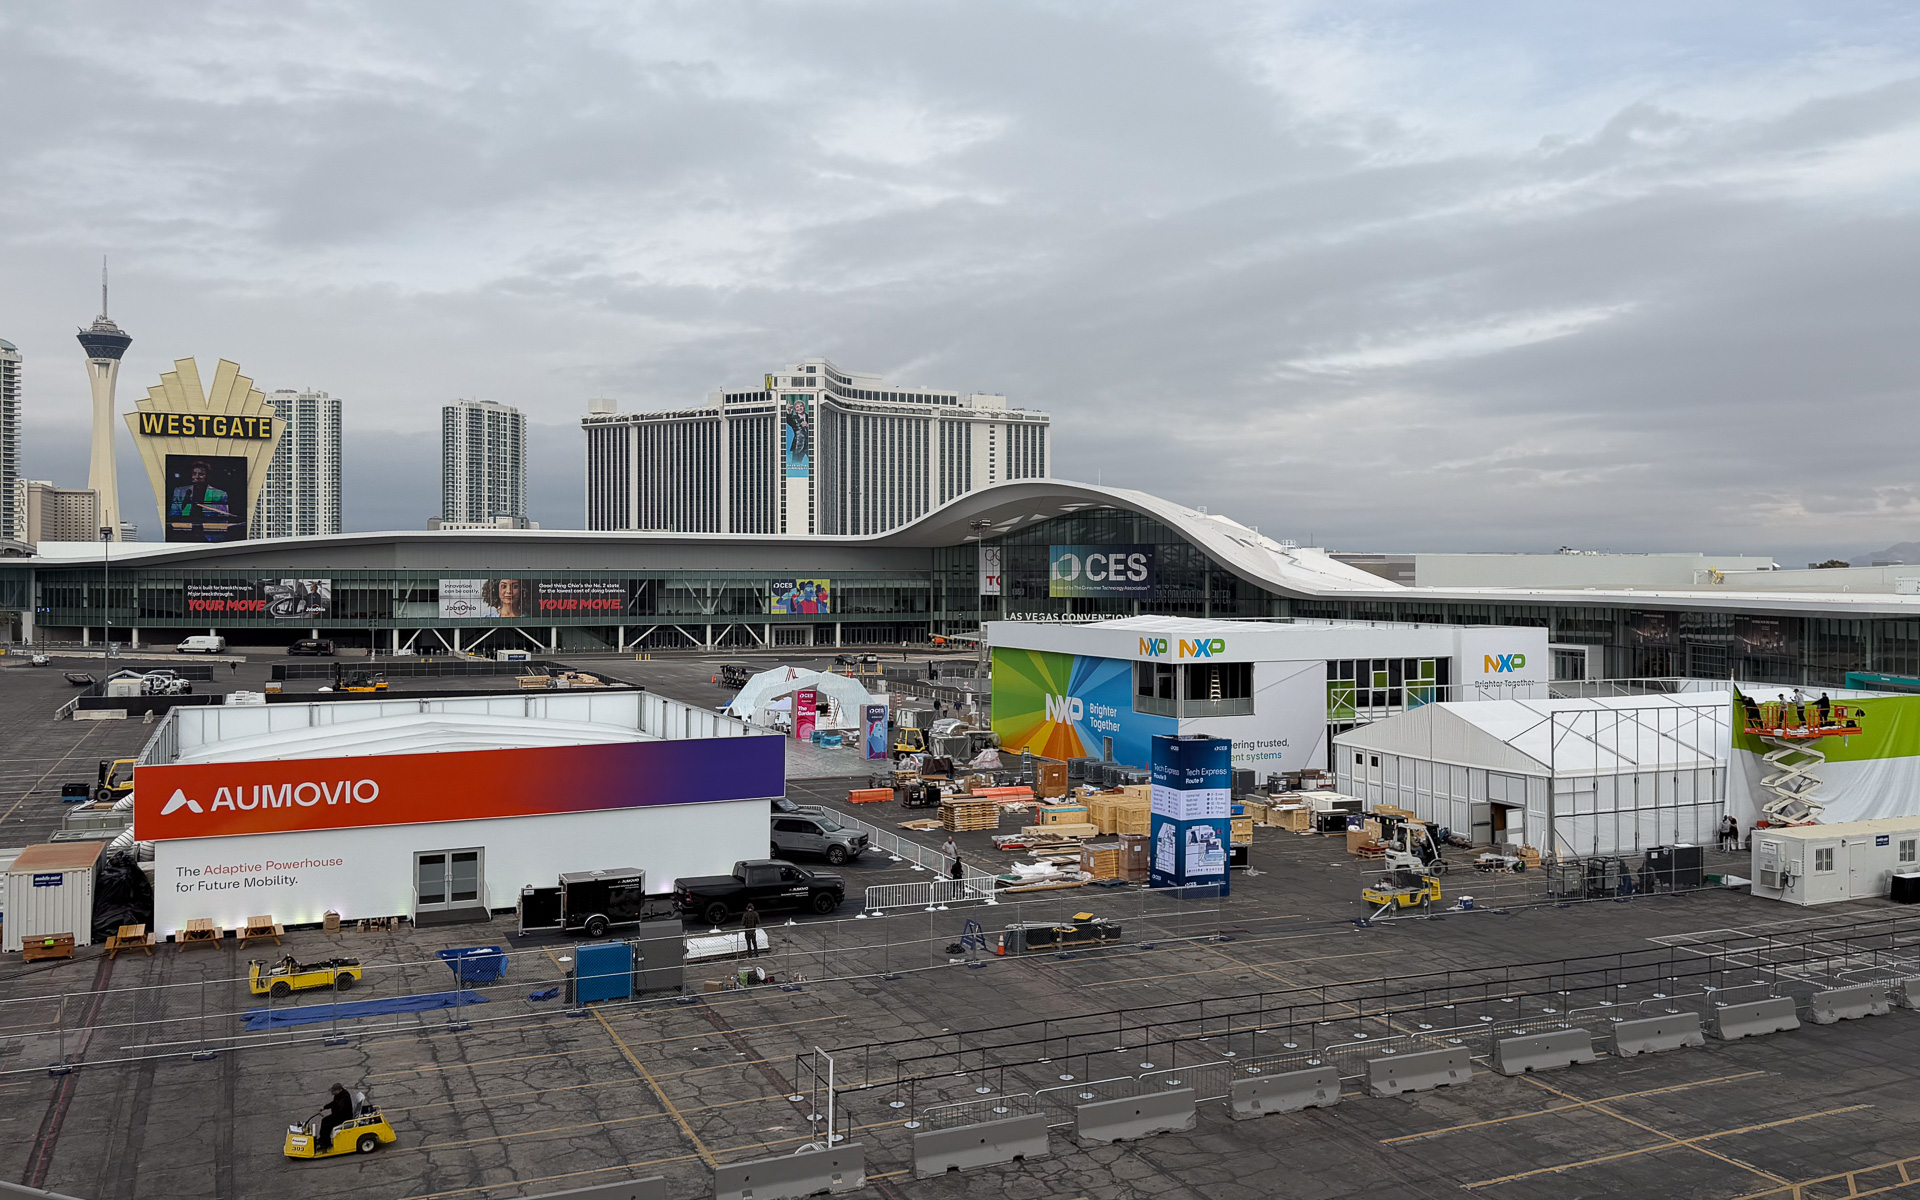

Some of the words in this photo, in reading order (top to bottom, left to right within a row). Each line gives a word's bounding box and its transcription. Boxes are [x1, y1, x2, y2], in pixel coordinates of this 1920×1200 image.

[142, 414, 270, 438] WESTGATE
[1085, 553, 1148, 582] CES
[188, 600, 225, 611] YOUR
[226, 600, 266, 611] MOVE
[539, 599, 578, 610] YOUR
[579, 599, 623, 610] MOVE.
[1004, 612, 1022, 620] LAS
[1025, 613, 1059, 621] VEGAS
[1139, 637, 1167, 657] NXP
[1179, 638, 1225, 658] NXP
[1484, 654, 1526, 673] NXP
[1475, 680, 1503, 690] Brighter
[1505, 679, 1535, 689] Together
[1046, 693, 1084, 725] NXP
[1090, 703, 1117, 718] Brighter
[1090, 717, 1120, 732] Together
[1257, 738, 1289, 748] trusted,
[1246, 752, 1282, 763] systems
[1154, 763, 1164, 772] Tech
[1165, 766, 1179, 776] Express
[1201, 768, 1227, 776] Express
[210, 779, 379, 812] AUMOVIO
[176, 866, 200, 877] The
[204, 862, 262, 875] Adaptive
[266, 858, 343, 871] Powerhouse
[176, 882, 194, 892] for
[198, 880, 240, 891] Future
[244, 875, 298, 888] Mobility.
